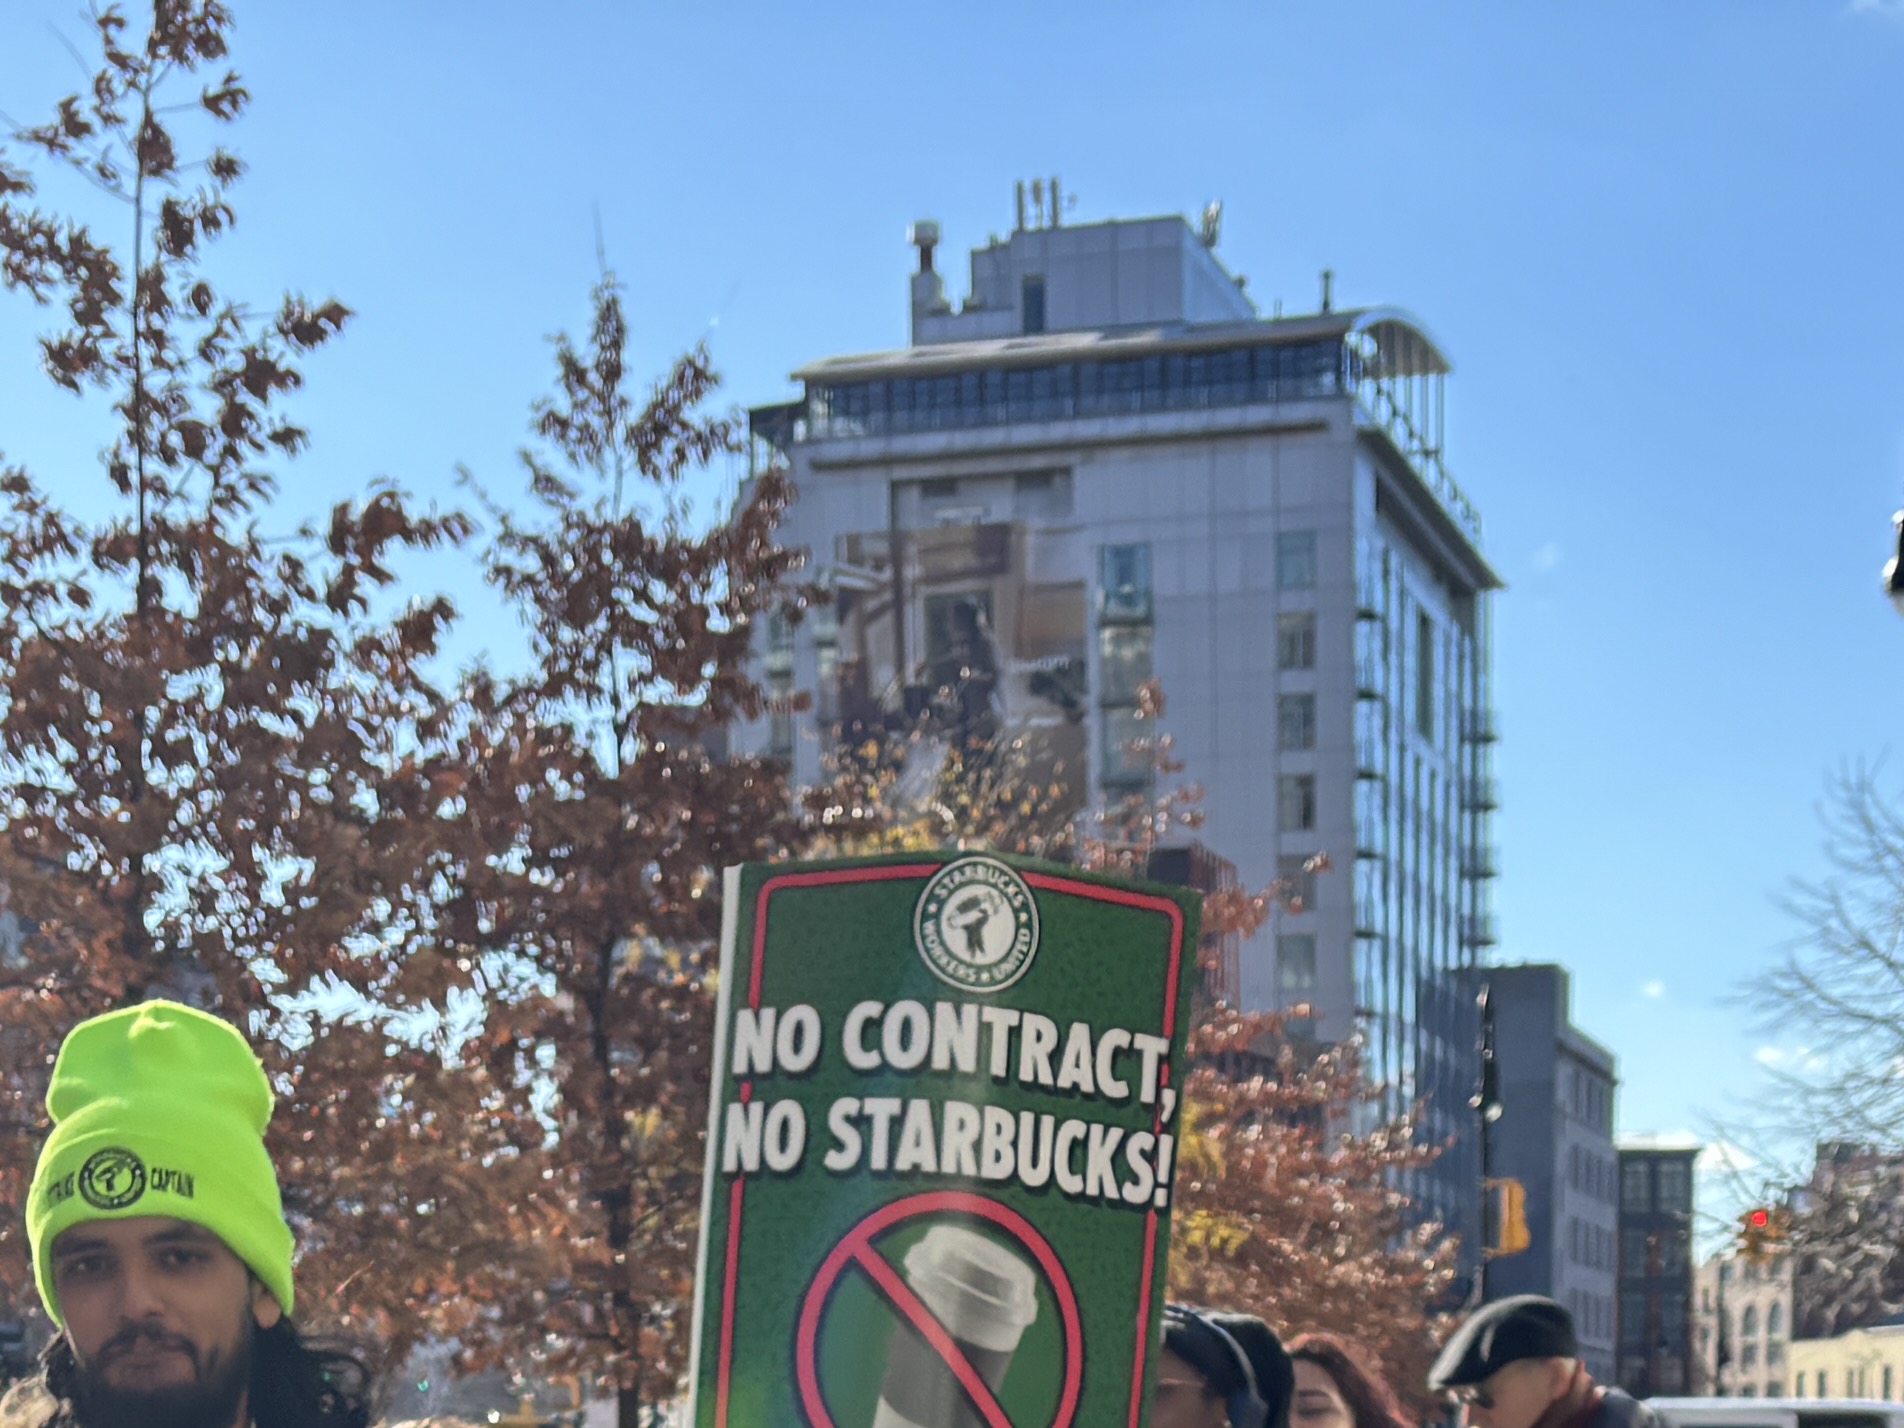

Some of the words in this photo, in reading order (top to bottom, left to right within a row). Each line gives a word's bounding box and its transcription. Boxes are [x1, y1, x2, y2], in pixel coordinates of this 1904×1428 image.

[933, 864, 1025, 909] STARBUCKS
[991, 927, 1031, 981] UNITED
[732, 1003, 822, 1076] NO
[842, 1000, 1177, 1123] CONTRACT,
[722, 1098, 807, 1174] NO
[823, 1096, 1175, 1208] STARBUCKS!
